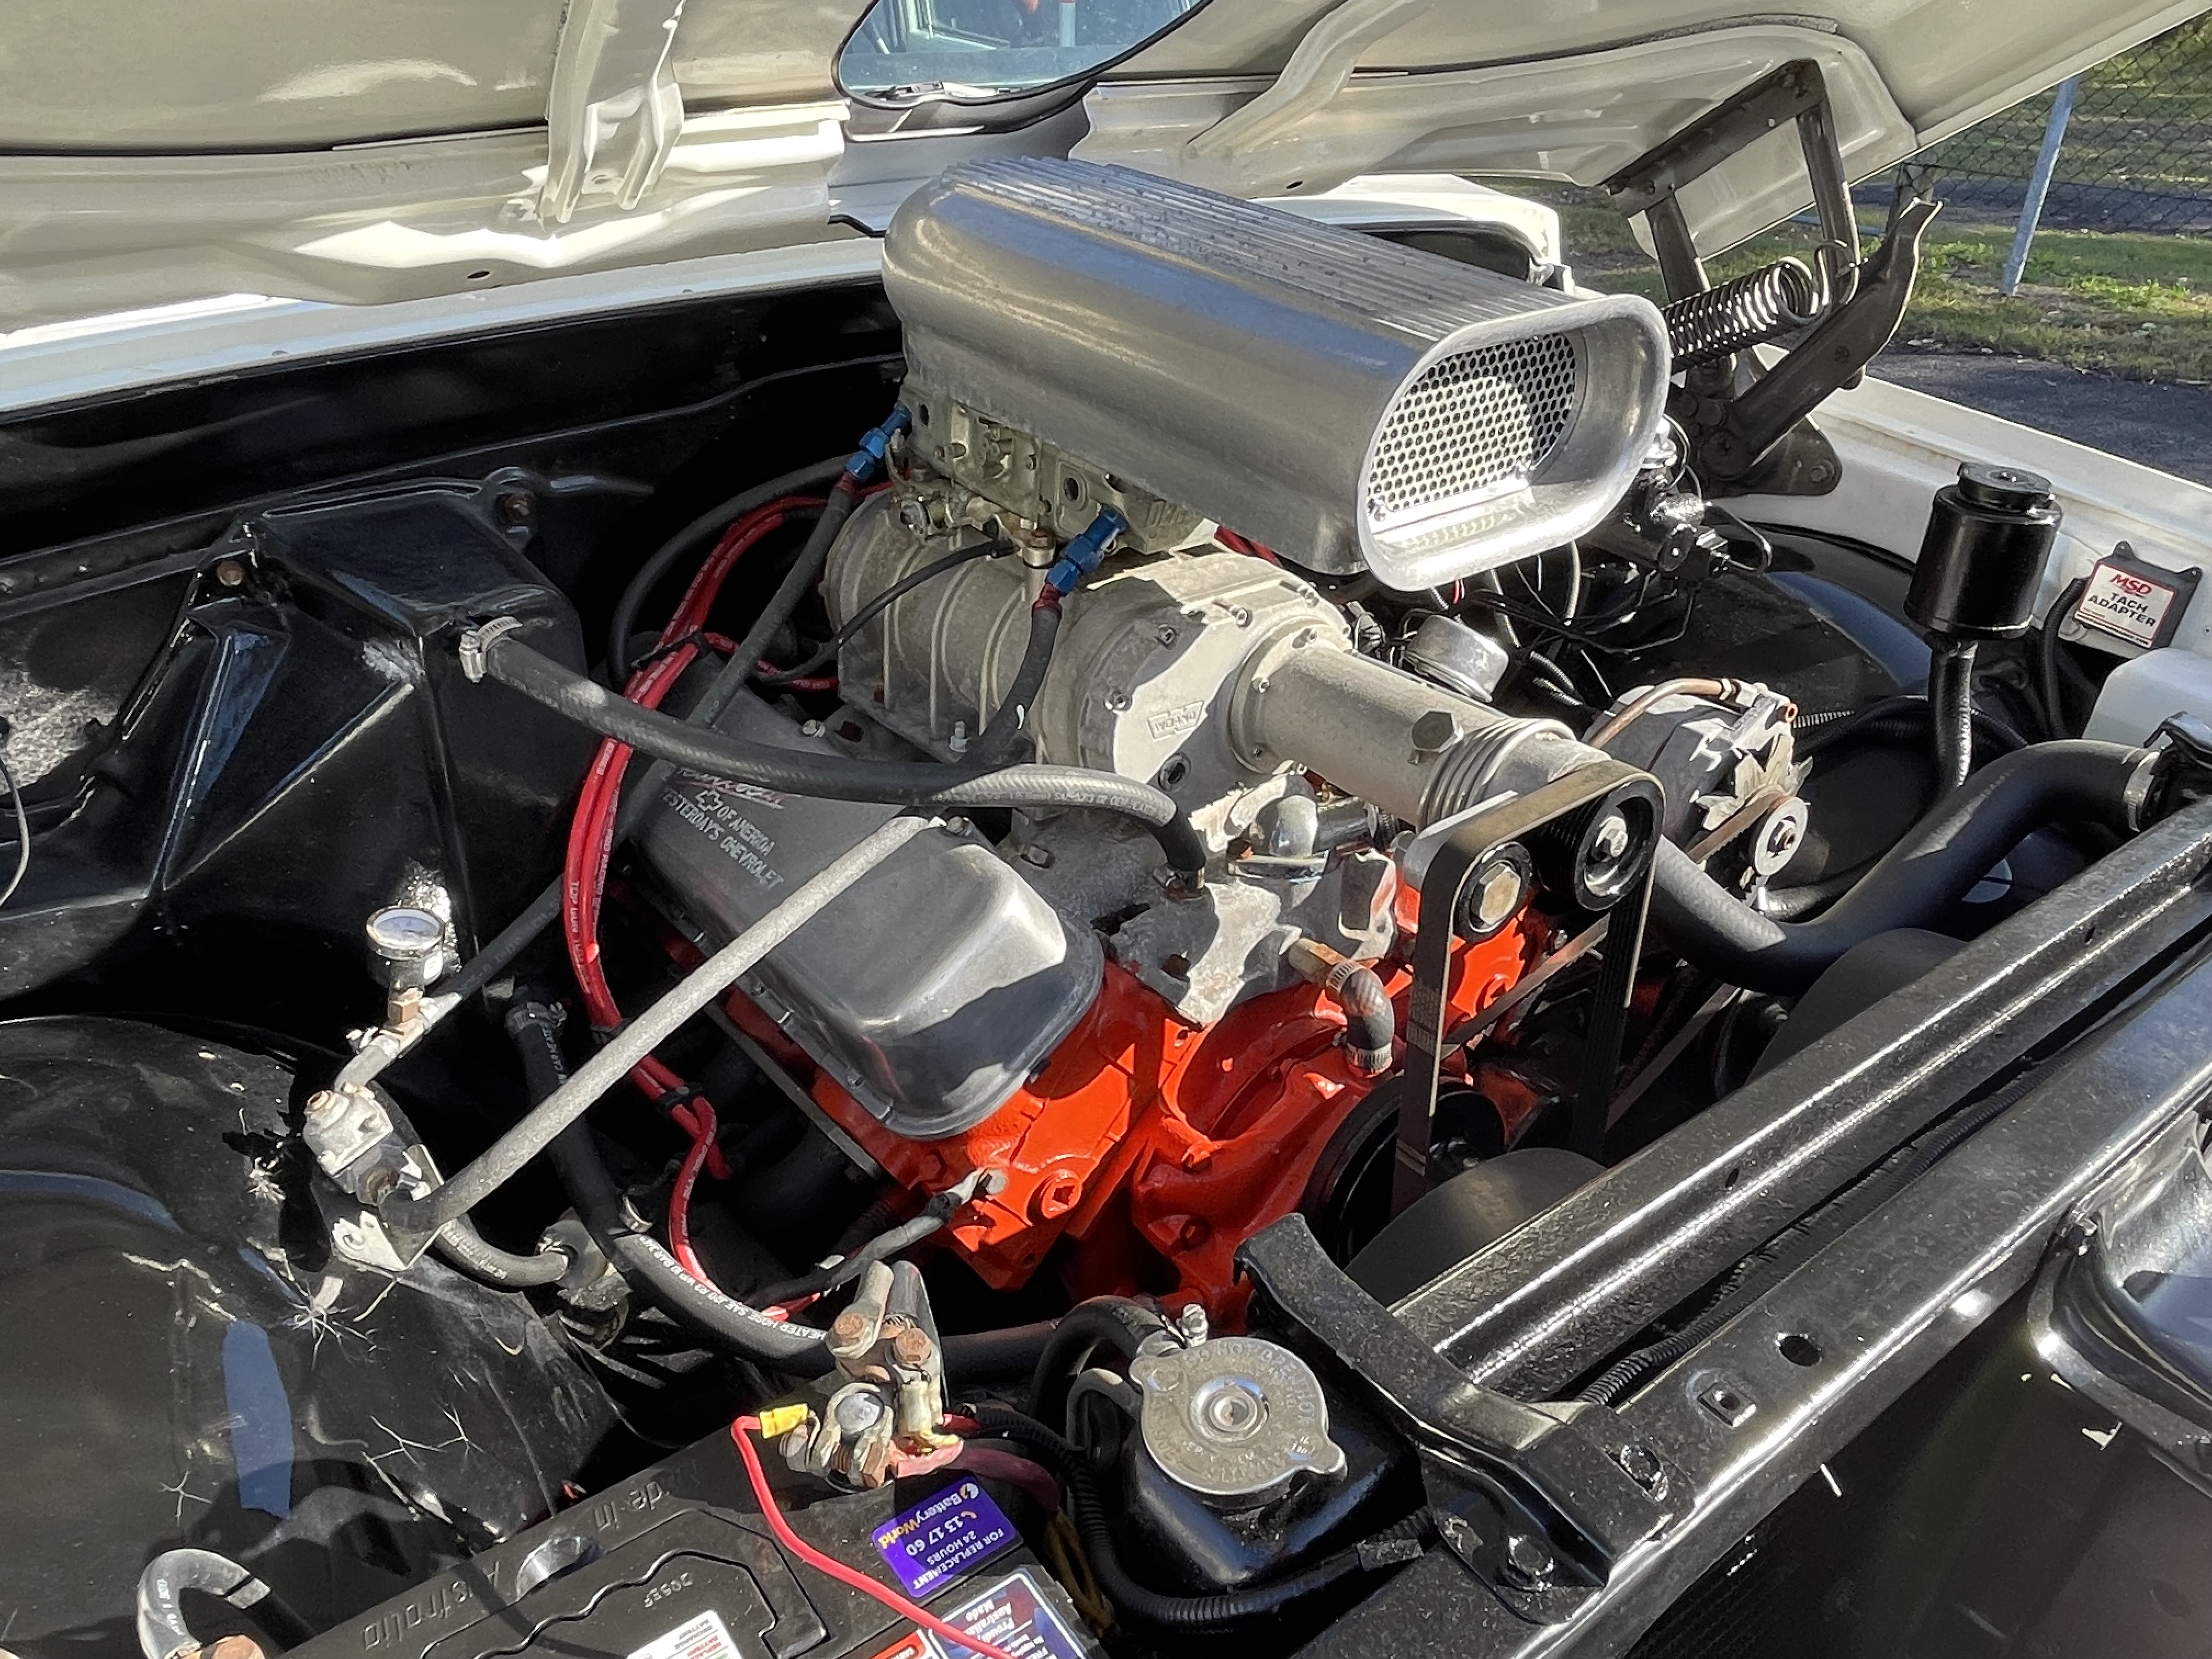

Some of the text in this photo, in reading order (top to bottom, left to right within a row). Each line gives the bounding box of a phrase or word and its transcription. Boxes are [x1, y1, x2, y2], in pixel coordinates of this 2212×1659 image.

[2110, 574, 2152, 595] MSD
[2087, 595, 2157, 627] ADAPTER
[2112, 592, 2148, 613] TACH
[780, 1323, 826, 1340] HEATER
[905, 1515, 963, 1557] 13 17 60
[926, 1531, 977, 1565] 24 HOURS
[913, 1528, 1005, 1589] FOR REPLACEMENT
[964, 1602, 1012, 1637] Australia
